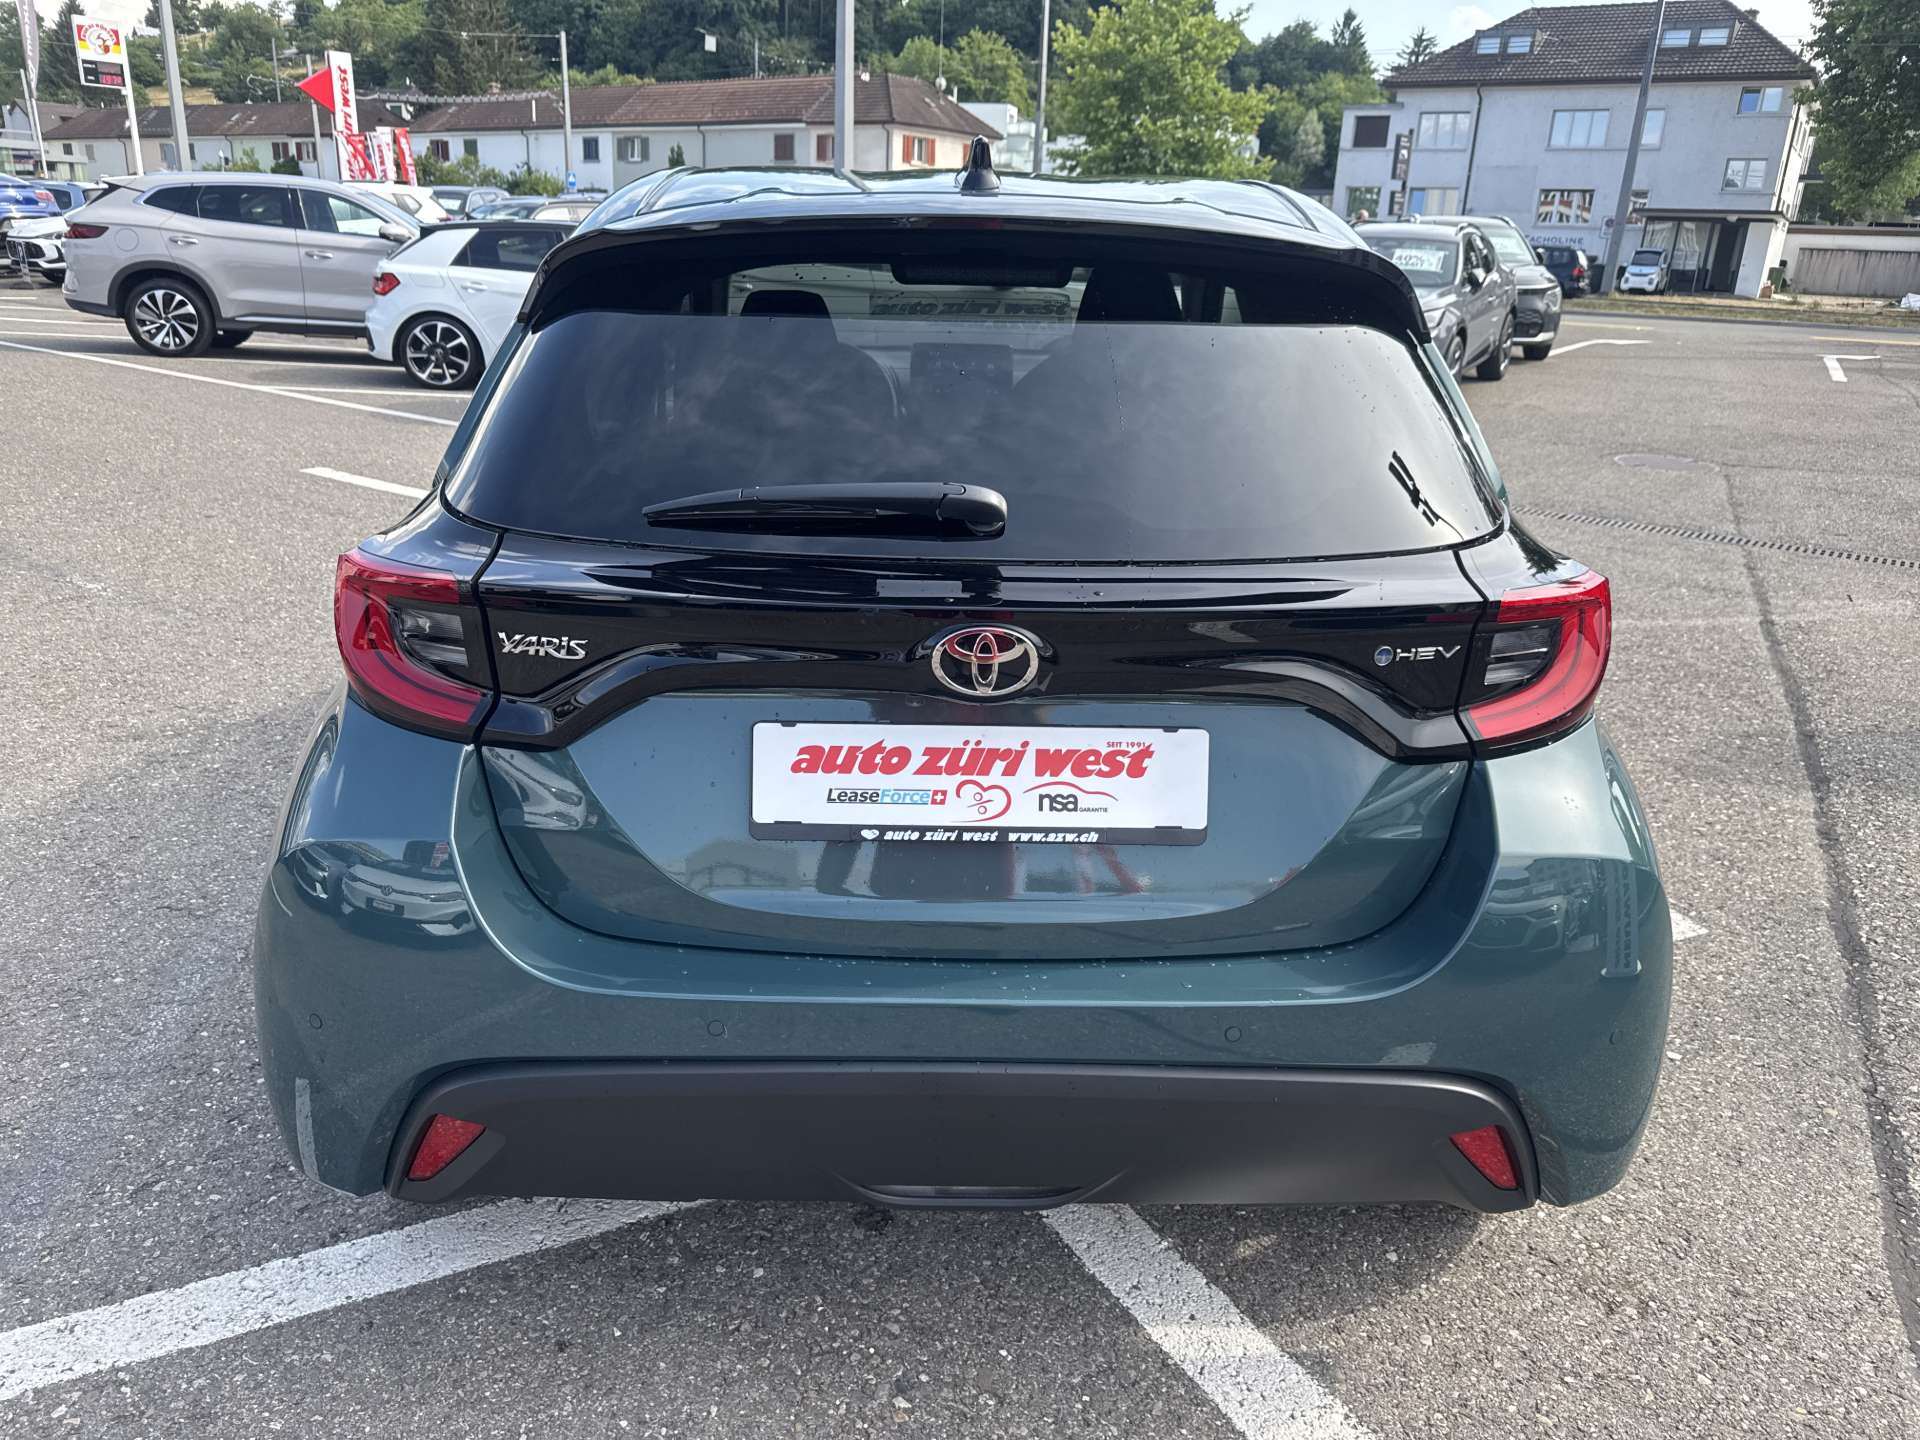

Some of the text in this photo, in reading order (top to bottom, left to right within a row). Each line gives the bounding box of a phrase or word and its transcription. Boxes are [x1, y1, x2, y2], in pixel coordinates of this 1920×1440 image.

[1396, 645, 1461, 662] HEV
[1106, 741, 1122, 749] SEIT
[790, 738, 1155, 779] auto züri west
[827, 787, 930, 804] LeaseForce
[1038, 793, 1079, 813] nsa
[884, 828, 1099, 843] auto züri west www.azw.ch
